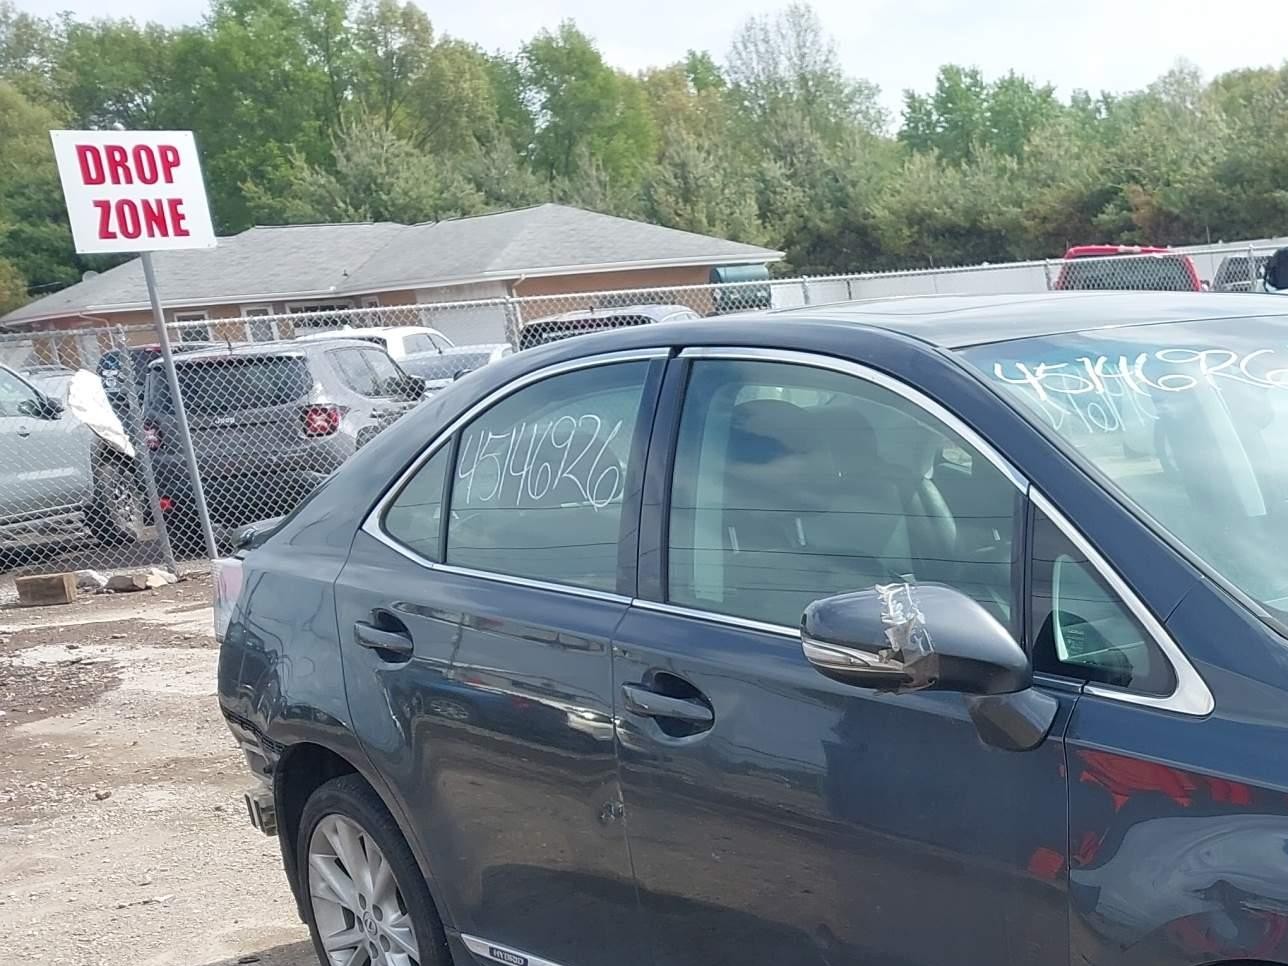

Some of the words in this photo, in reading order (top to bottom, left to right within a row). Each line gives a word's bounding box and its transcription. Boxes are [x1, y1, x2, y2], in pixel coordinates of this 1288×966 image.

[75, 144, 181, 185] DROP
[92, 198, 190, 240] ZONE
[458, 414, 623, 512] 45146926
